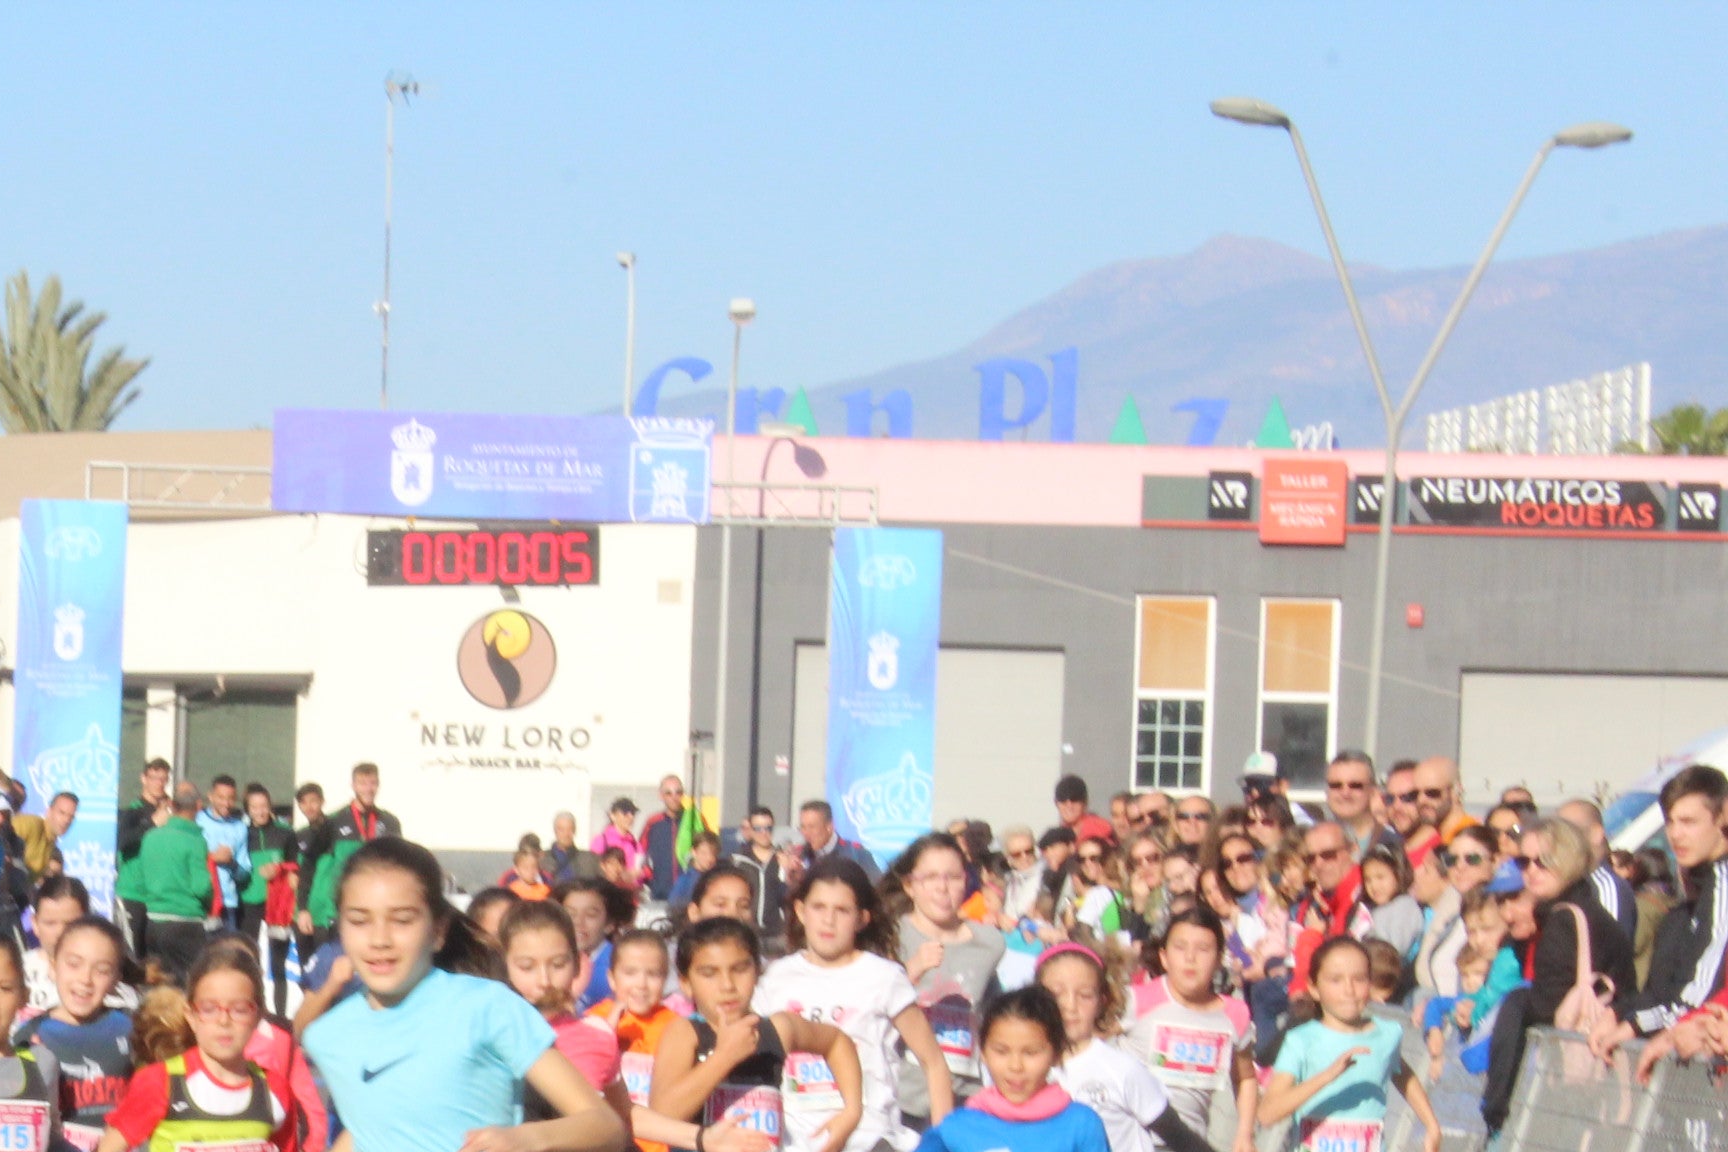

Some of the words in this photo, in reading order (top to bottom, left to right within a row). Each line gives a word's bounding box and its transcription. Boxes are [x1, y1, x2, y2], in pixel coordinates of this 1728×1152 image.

[1280, 474, 1328, 488] TALLER
[1500, 502, 1656, 529] ROQUETAS
[421, 723, 486, 746] NEW
[503, 725, 591, 752] LORO
[469, 758, 511, 769] SNACK
[515, 758, 542, 769] BAR
[1174, 1042, 1213, 1064] 923
